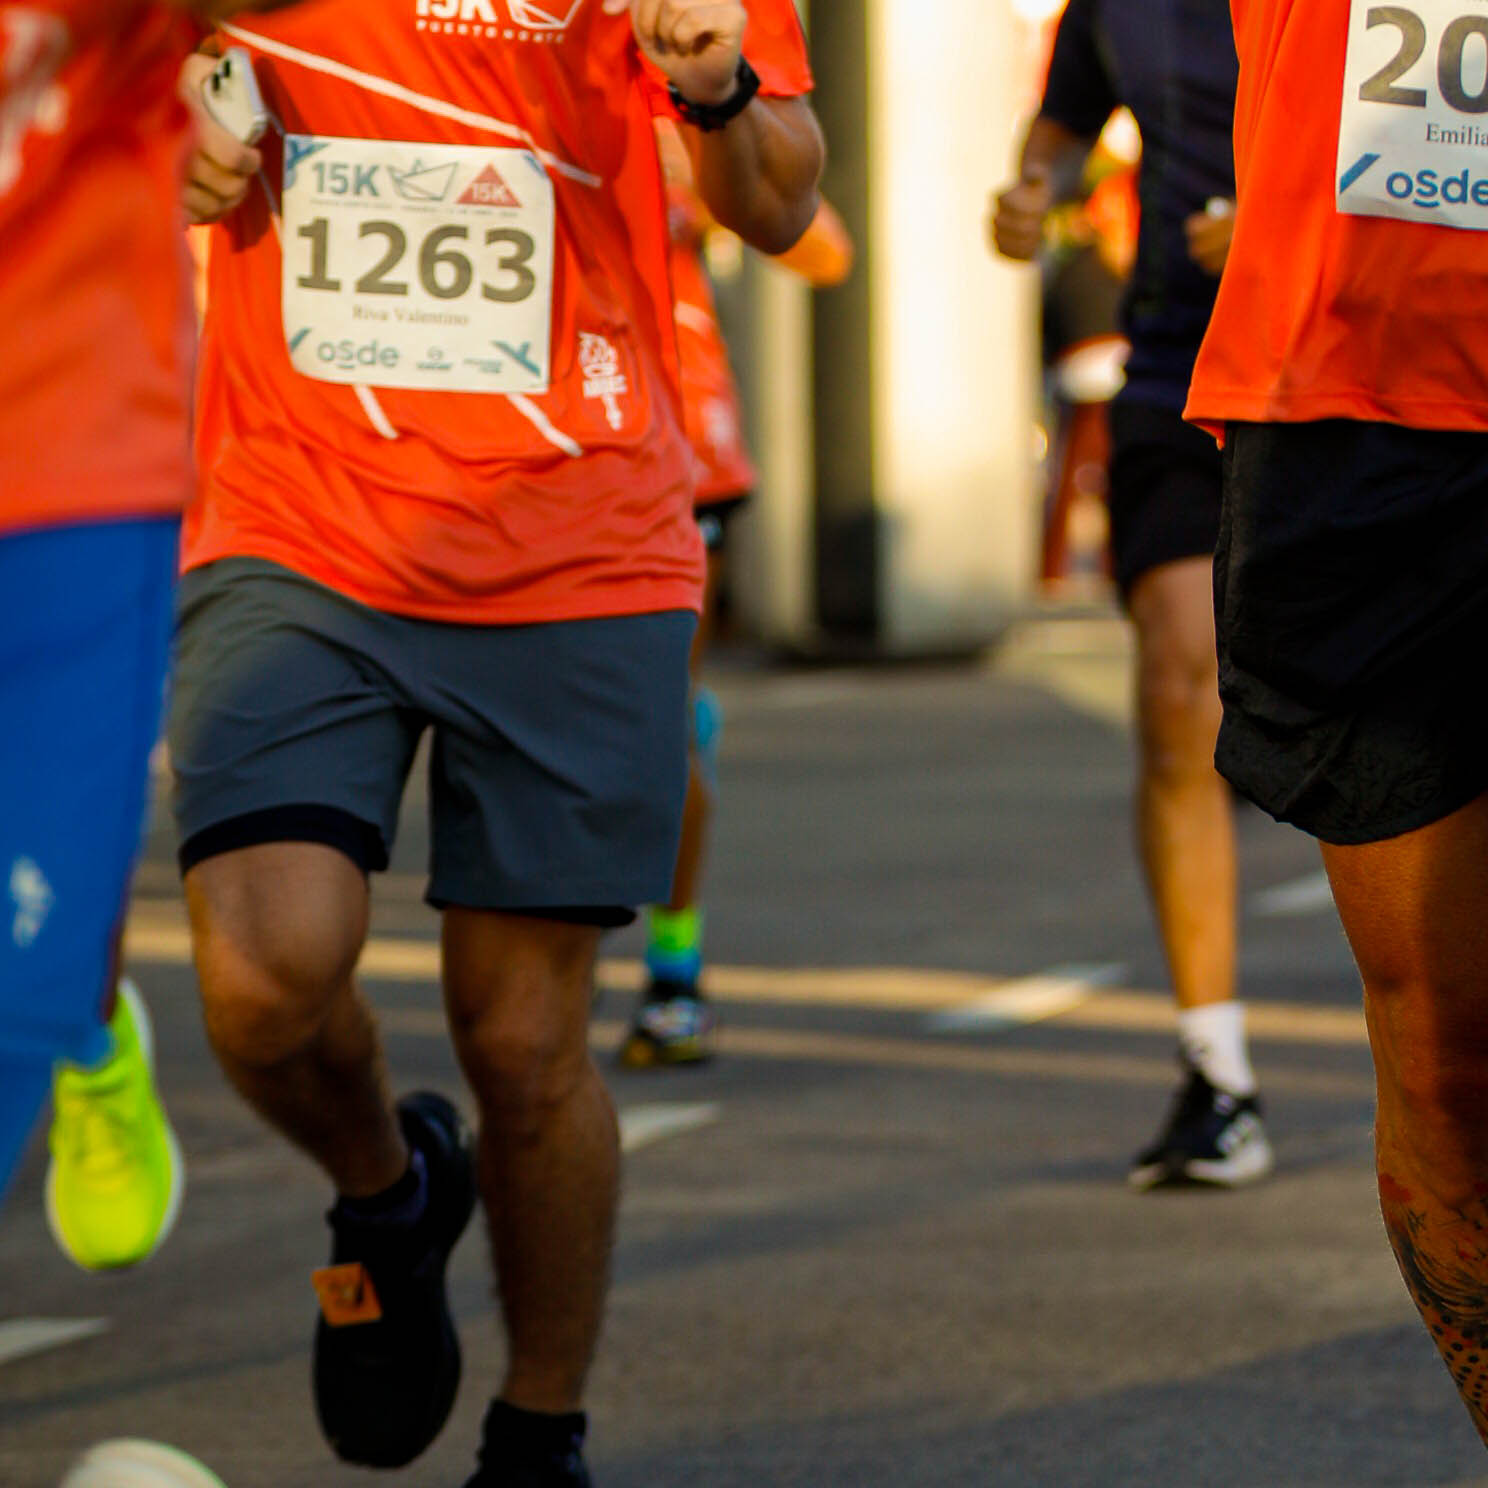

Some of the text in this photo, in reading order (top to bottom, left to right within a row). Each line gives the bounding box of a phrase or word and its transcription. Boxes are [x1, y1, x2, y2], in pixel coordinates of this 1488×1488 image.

[312, 161, 381, 198] 15K
[296, 216, 537, 304] 1263
[317, 340, 400, 368] osde
